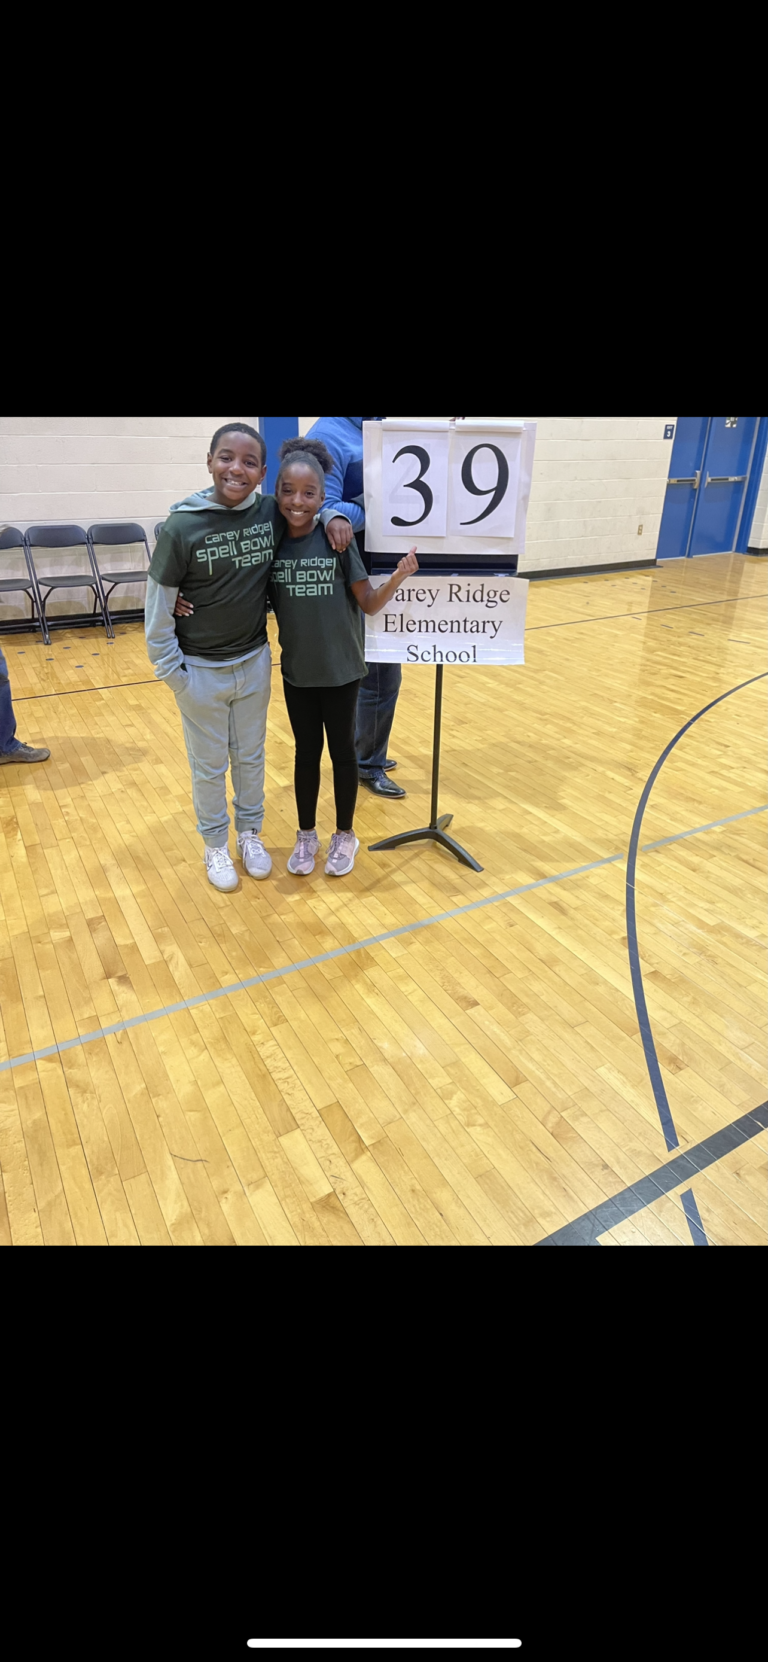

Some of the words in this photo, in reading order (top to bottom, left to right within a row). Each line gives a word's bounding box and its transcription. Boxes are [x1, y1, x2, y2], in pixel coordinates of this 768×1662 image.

[379, 583, 440, 608] arey
[446, 583, 511, 609] Ridge
[382, 613, 503, 639] Elementary
[406, 644, 478, 663] School
